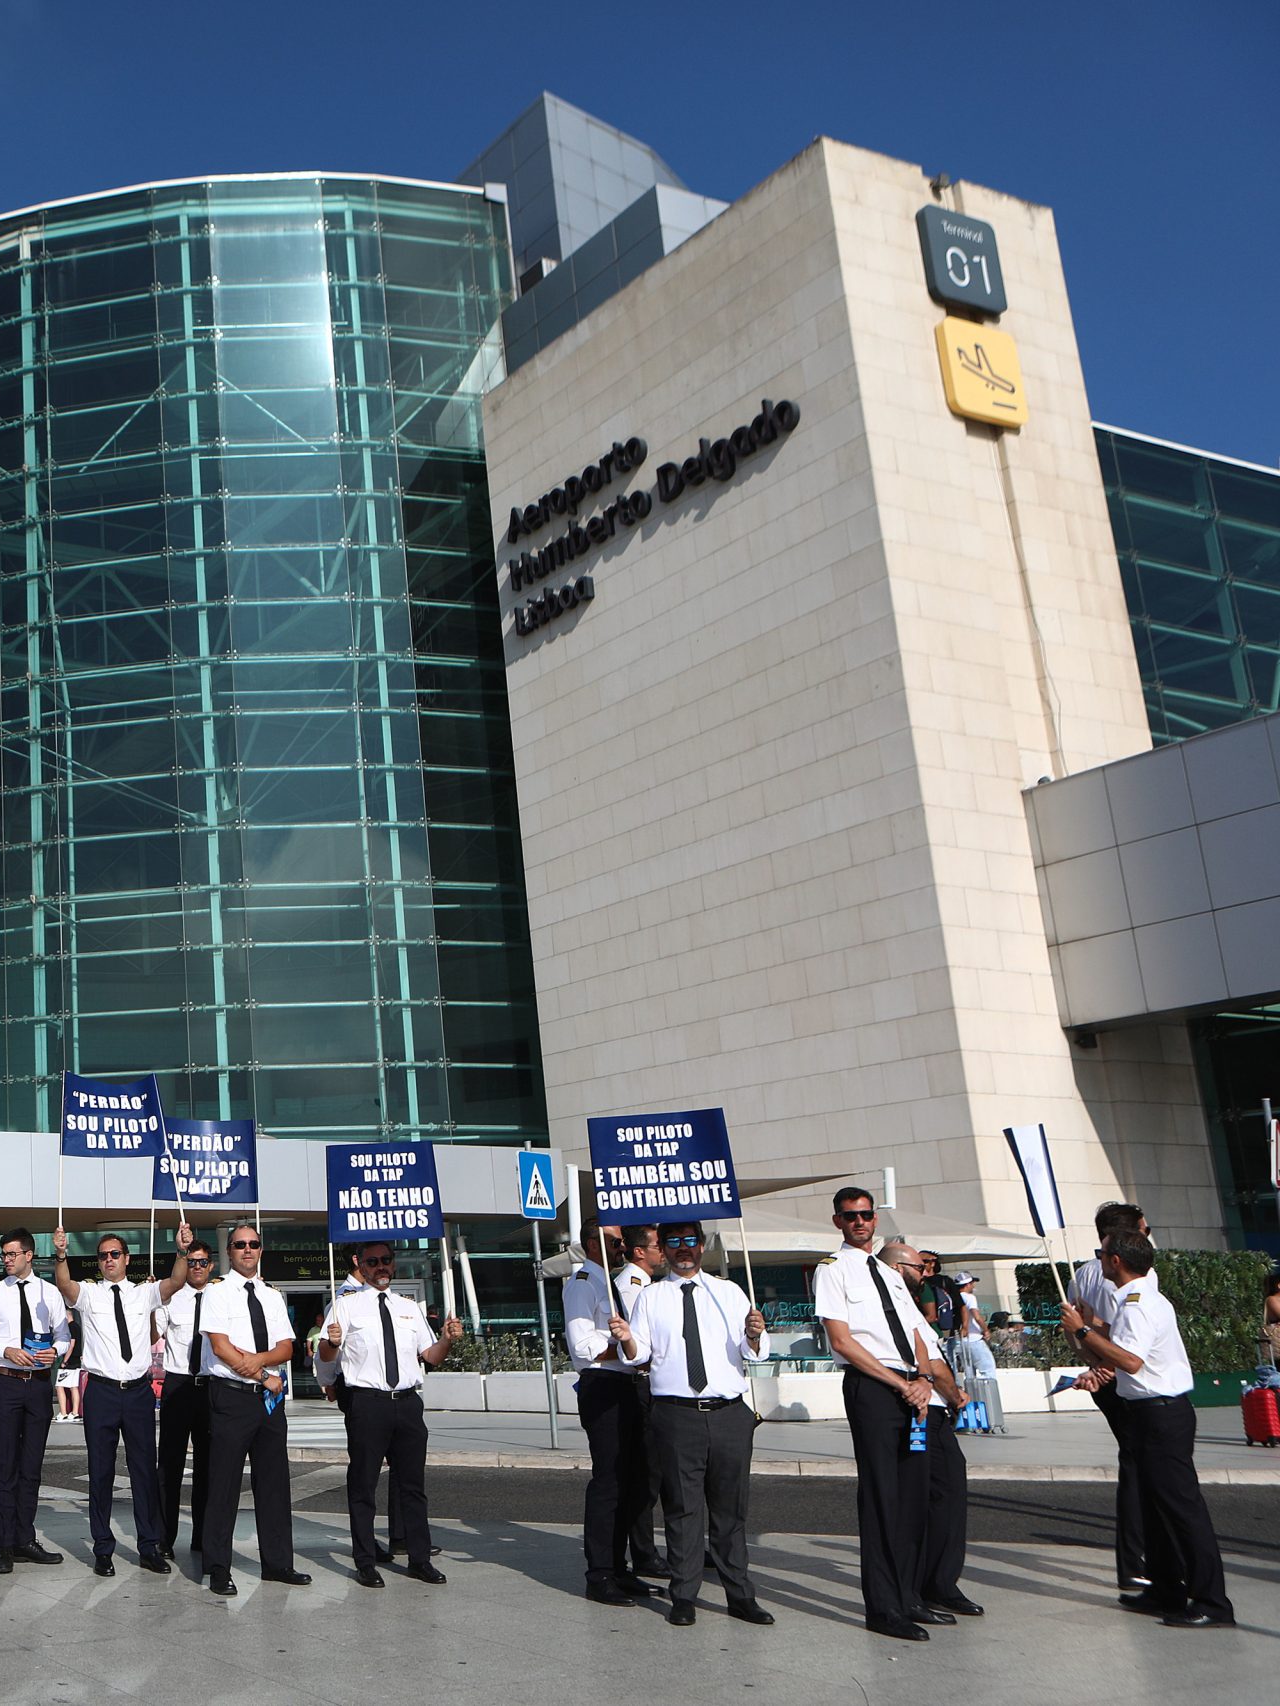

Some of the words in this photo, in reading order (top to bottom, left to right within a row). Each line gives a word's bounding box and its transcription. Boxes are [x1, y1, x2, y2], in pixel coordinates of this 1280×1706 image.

[942, 220, 983, 243] Terminal
[946, 246, 991, 295] 01
[507, 436, 648, 543] Aeroporto
[509, 490, 652, 591] Humberto
[656, 398, 800, 503] Delgado
[514, 575, 595, 636] Lisboa
[66, 1114, 98, 1132] SOU
[104, 1115, 158, 1133] PILOTO
[616, 1127, 643, 1143] SOU
[646, 1123, 693, 1140] PILOTO
[86, 1134, 108, 1149] DA
[112, 1135, 143, 1150] TAP
[633, 1143, 653, 1159] DA
[654, 1141, 680, 1157] TAP
[160, 1158, 190, 1175] SOU
[195, 1161, 249, 1177] PILOTO
[350, 1154, 372, 1168] SOU
[375, 1152, 417, 1167] PILOTO
[363, 1169, 380, 1182] DA
[381, 1168, 403, 1182] TAP
[594, 1168, 605, 1187] E
[608, 1161, 685, 1186] TAMBÉM
[689, 1159, 727, 1181] SOU
[178, 1177, 197, 1193] DA
[202, 1178, 231, 1194] TAP
[339, 1187, 372, 1209] NÃO
[377, 1187, 434, 1207] TENHO
[597, 1183, 732, 1211] CONTRIBUINTE
[347, 1209, 429, 1231] DIREITOS
[283, 1255, 328, 1263] bem-vindo
[1041, 1302, 1061, 1317] Bis
